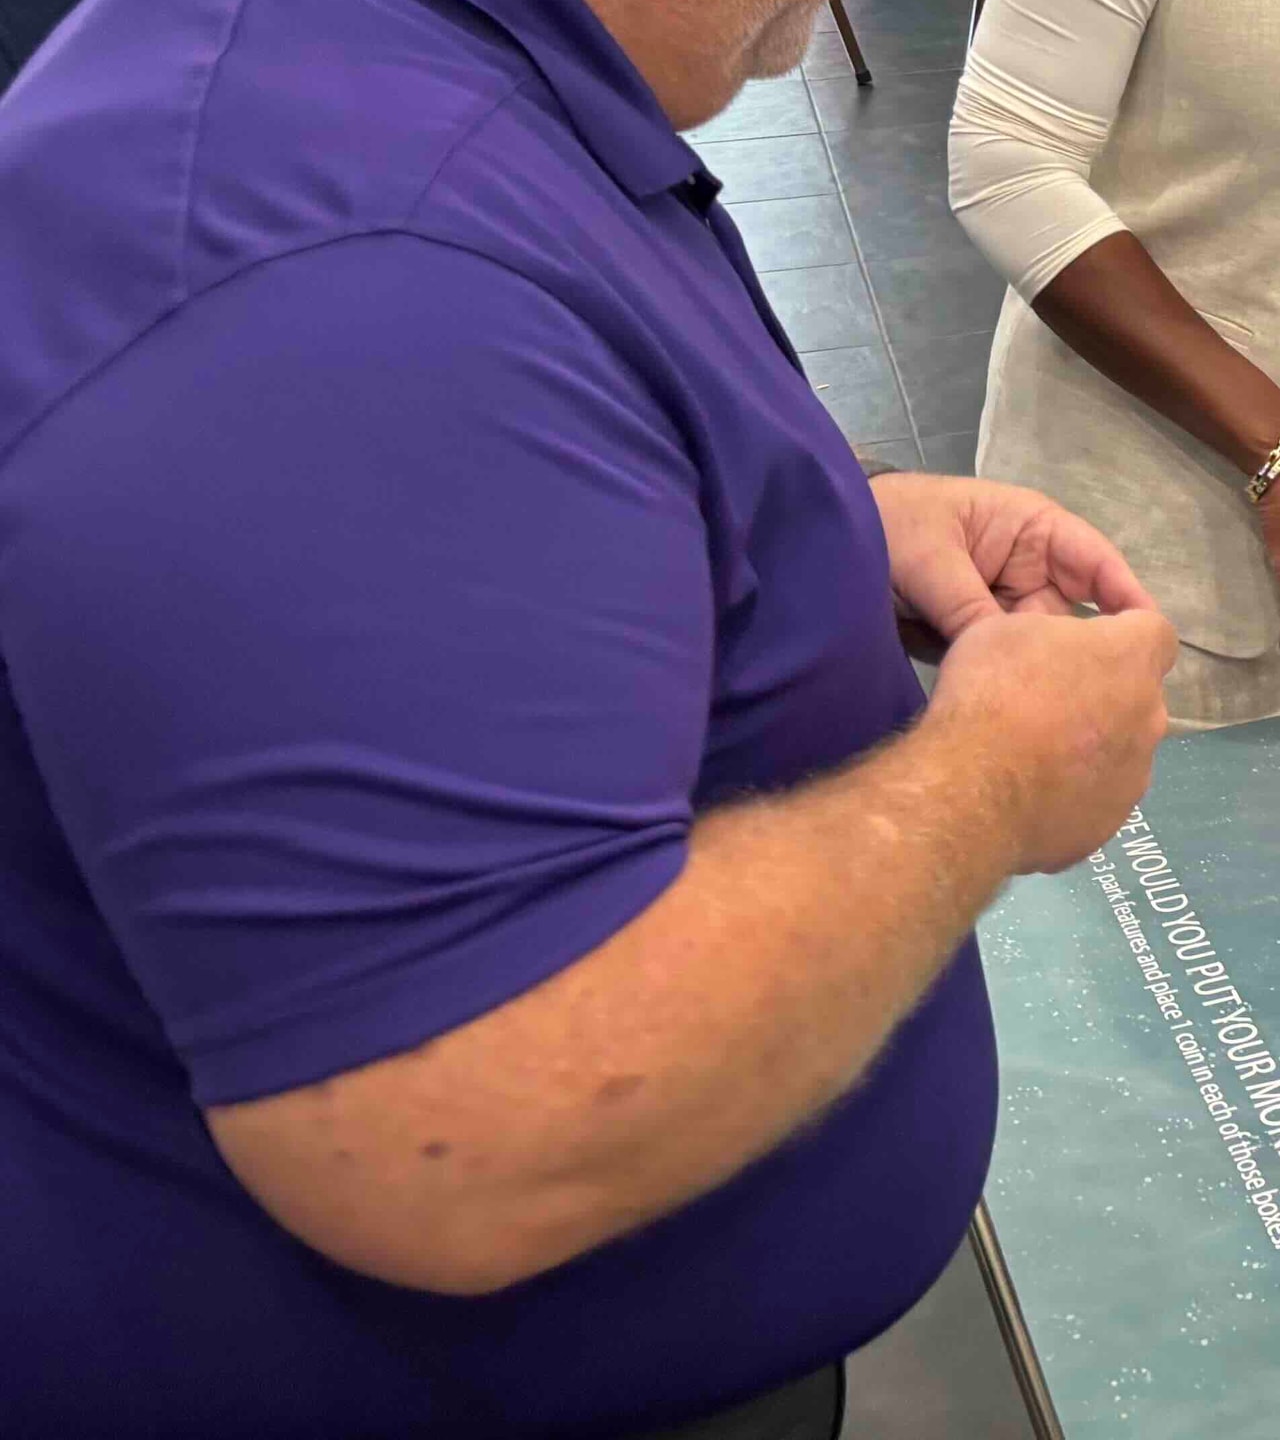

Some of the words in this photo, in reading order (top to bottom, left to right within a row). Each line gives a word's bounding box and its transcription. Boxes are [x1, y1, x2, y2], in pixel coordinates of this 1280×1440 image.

[1093, 862, 1116, 873] 3
[1121, 834, 1189, 913] WOULD
[1091, 873, 1130, 903] park
[1111, 900, 1151, 954] features
[1161, 911, 1217, 961] YOU
[1136, 954, 1172, 982] and
[1185, 961, 1243, 1007] PUT
[1143, 981, 1183, 1021] place
[1170, 1019, 1193, 1030] 1
[1211, 1006, 1277, 1080] YOUR
[1175, 1032, 1207, 1066] coin
[1190, 1063, 1216, 1083] in
[1199, 1082, 1238, 1122] each
[1219, 1122, 1252, 1141] of
[1227, 1138, 1267, 1191] those
